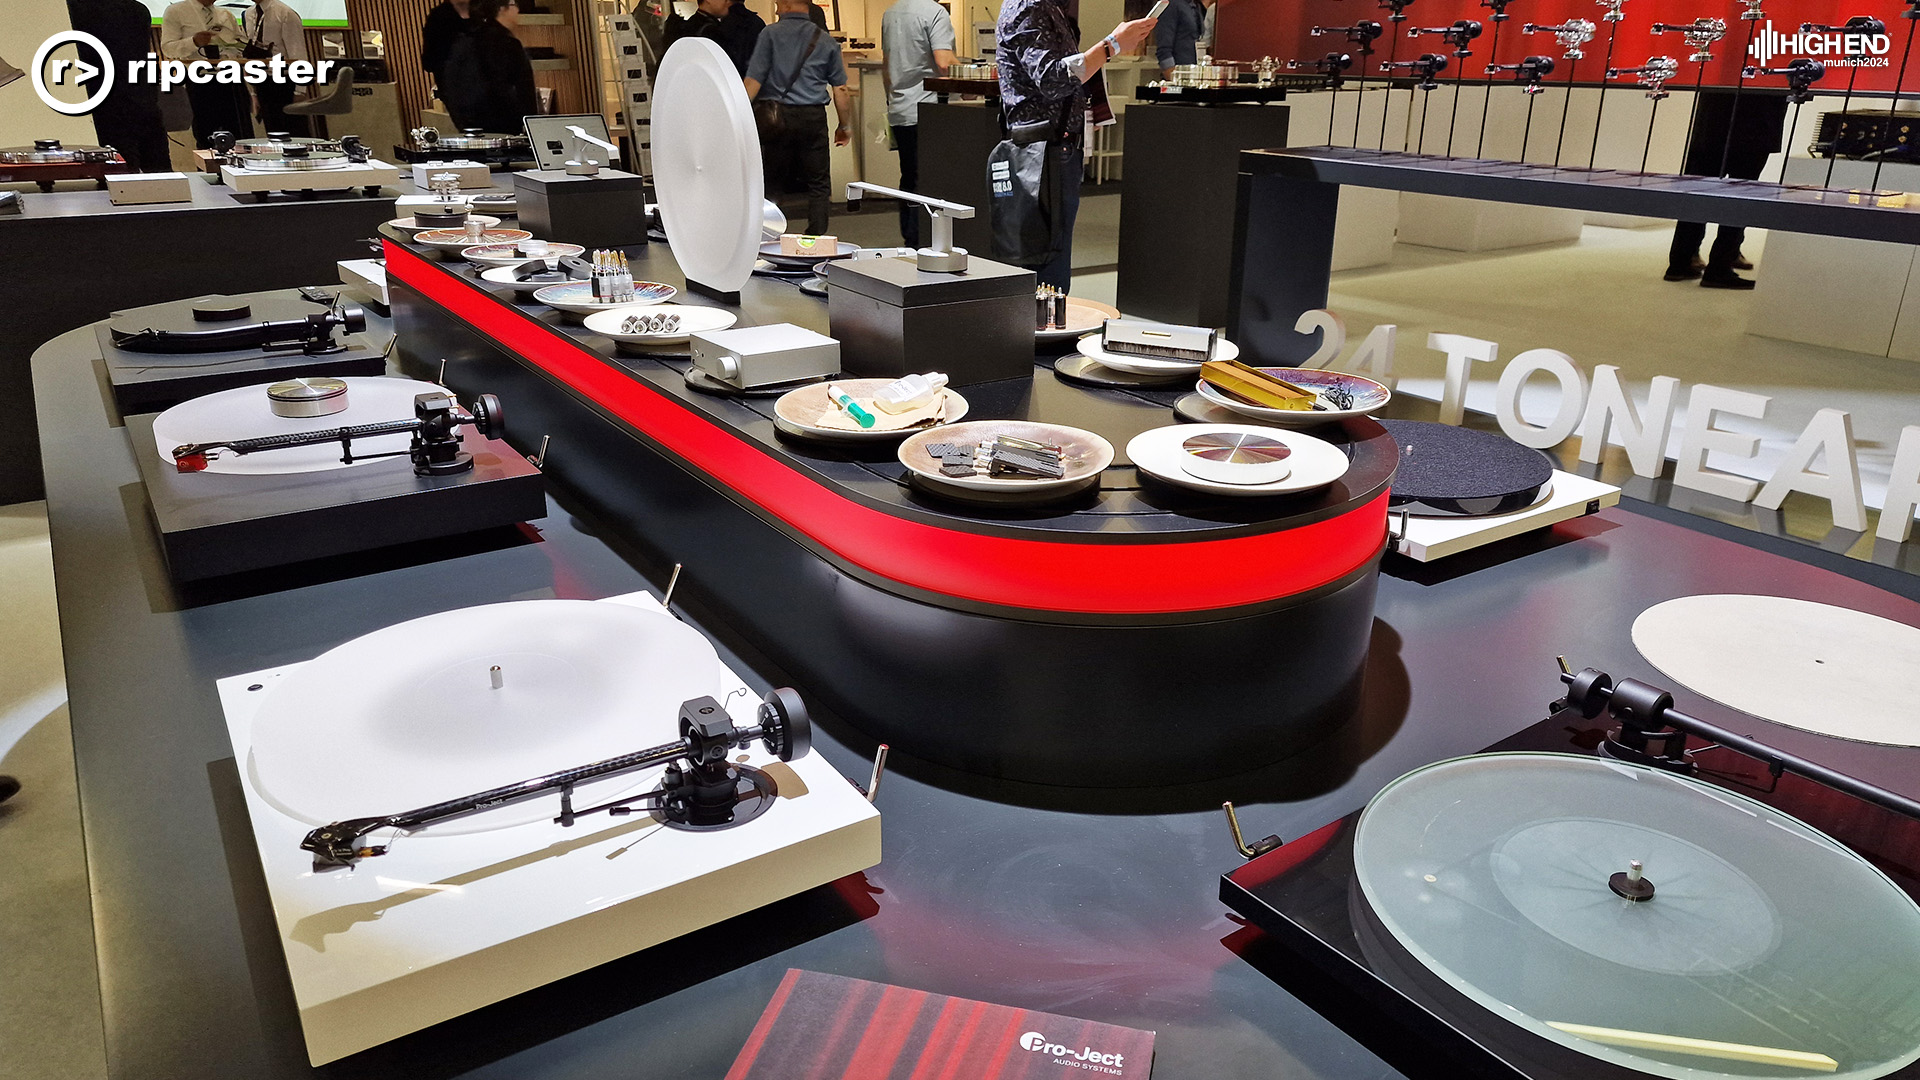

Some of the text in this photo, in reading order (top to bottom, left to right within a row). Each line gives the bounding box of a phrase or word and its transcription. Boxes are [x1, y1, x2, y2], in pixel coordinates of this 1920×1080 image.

[1294, 308, 1399, 390] 24
[1019, 1031, 1125, 1068] Pro-Ject
[1053, 1058, 1123, 1076] AUDIO SYSTEMS
